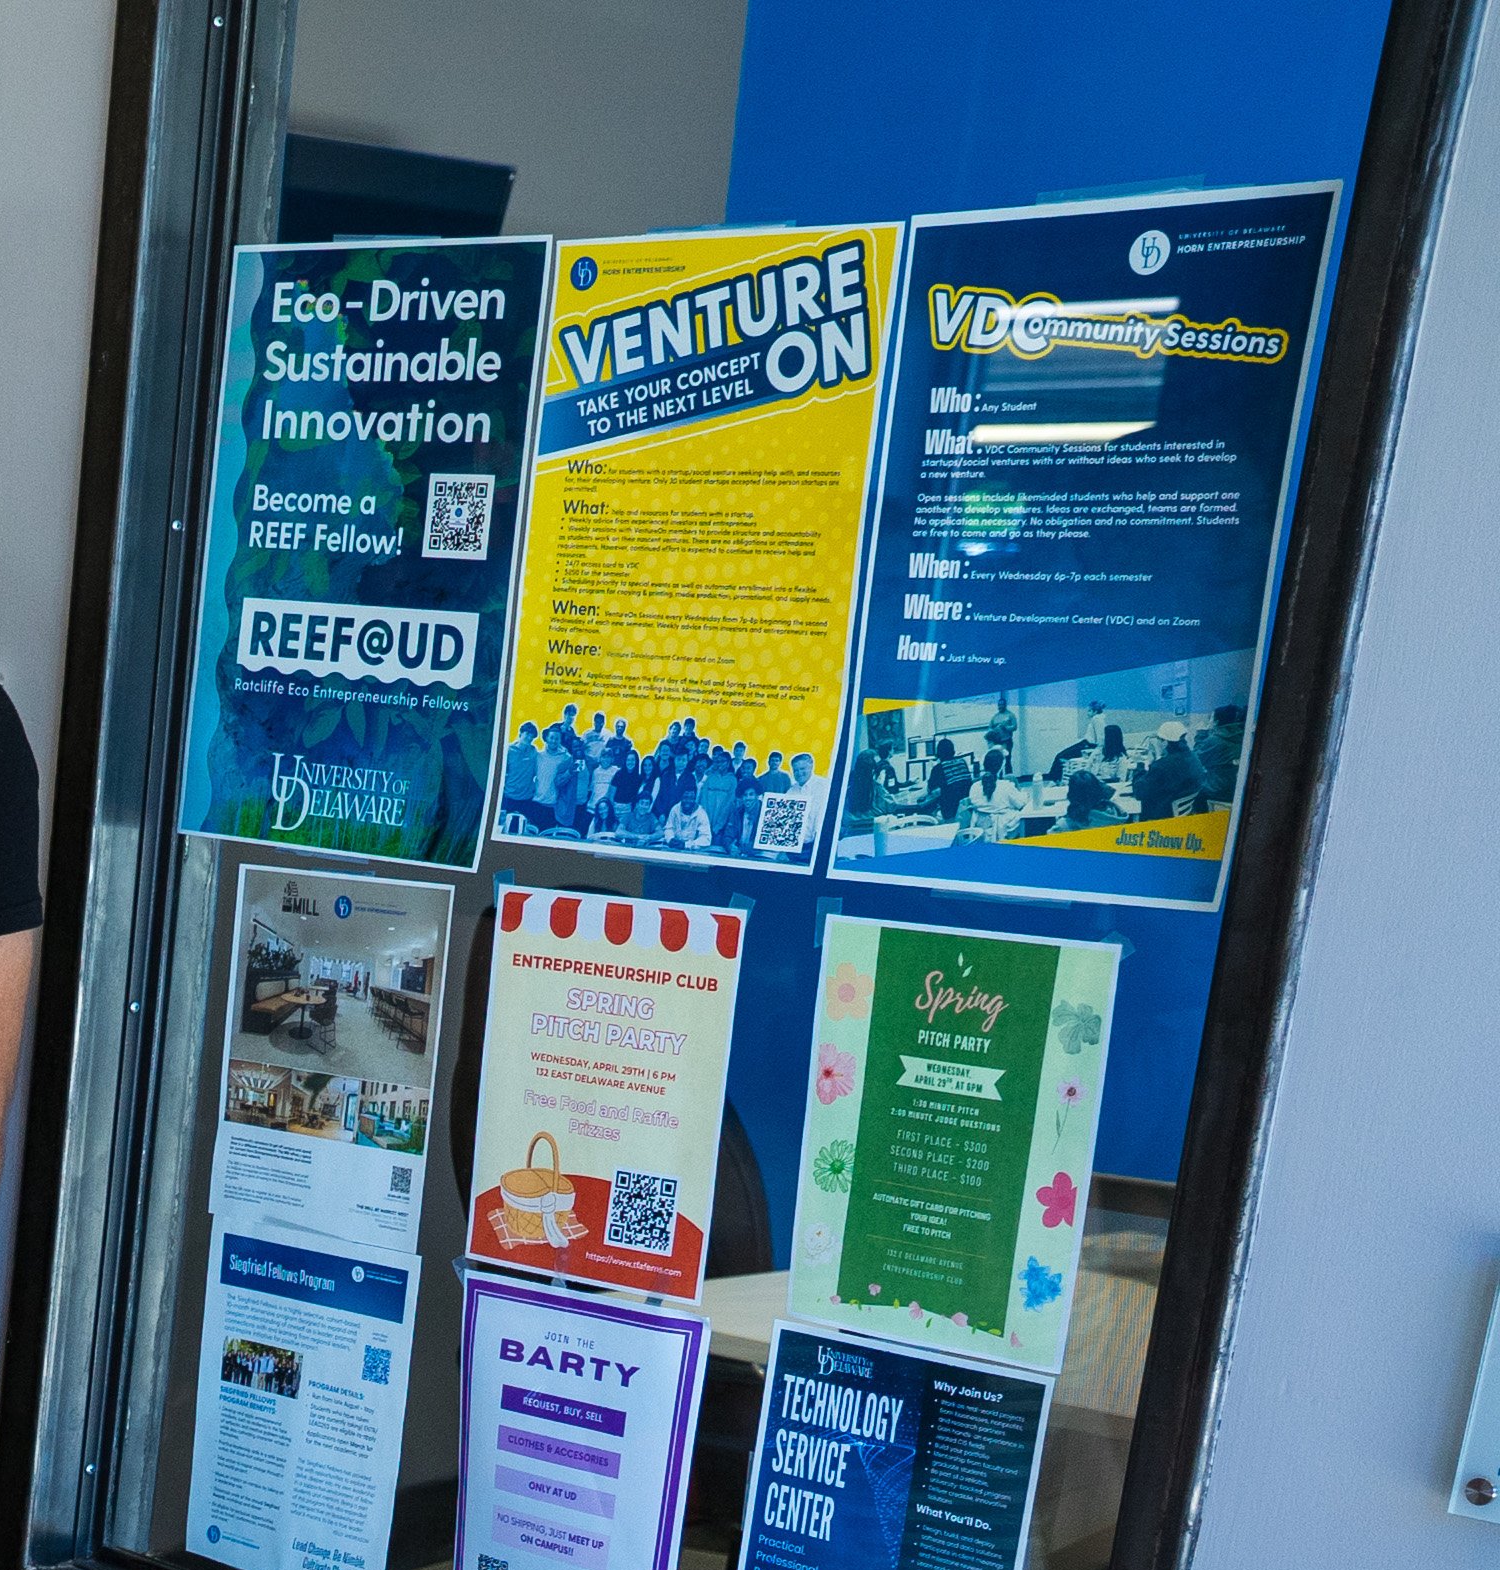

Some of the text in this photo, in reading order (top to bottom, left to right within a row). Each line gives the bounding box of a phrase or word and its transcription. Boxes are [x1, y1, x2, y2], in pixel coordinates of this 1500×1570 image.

[1177, 235, 1306, 254] HORN ENTREPRENEURSHIP
[270, 277, 509, 322] Eco-Driven
[563, 246, 864, 385] VENTURE
[765, 312, 867, 393] ON
[1164, 323, 1281, 356] Sessions
[261, 338, 504, 383] Sustainable
[577, 352, 761, 418] TAKE YOUR CONCEPT
[260, 399, 494, 443] Innovation
[587, 378, 754, 437] TO THE NEXT LEVEL
[980, 403, 999, 412] Any
[1000, 401, 1037, 412] Student
[567, 459, 607, 475] Who:
[251, 485, 377, 515] Become a
[563, 500, 610, 515] What:
[248, 521, 404, 556] REEF Fellow!
[969, 571, 996, 581] Every
[997, 571, 1052, 582] Wednesday
[1053, 571, 1081, 582] 6p-7p
[1083, 572, 1107, 582] each
[1108, 572, 1152, 583] semester
[552, 600, 600, 617] When:
[971, 612, 1007, 622] Venture
[1008, 613, 1069, 624] Development
[1071, 614, 1103, 625] Center
[1104, 615, 1134, 625] (VDC)
[1135, 616, 1155, 626] and
[1157, 616, 1170, 626] on
[1172, 616, 1200, 627] Zoom
[248, 610, 466, 672] REEF@UD
[548, 639, 601, 656] Where:
[544, 661, 582, 678] How:
[945, 653, 965, 664] Just
[967, 654, 991, 664] show
[992, 655, 1007, 665] up.
[233, 678, 469, 714] Ratcliffe Eco Entrepreneurship Fellows
[272, 753, 410, 798] UNIVERSITY OF
[271, 776, 405, 831] DELAWARE
[1116, 829, 1205, 853] Just Show Up.
[293, 897, 320, 917] MILL
[512, 953, 718, 991] ENTREPRENEURSHIP CLUB
[565, 987, 655, 1020] SPRING
[915, 970, 1009, 1033] Spring
[530, 1012, 687, 1057] PITCH PARTY
[918, 1030, 992, 1054] PITCH PARTY
[530, 1051, 676, 1083] WEDNESDAY, APRIL 29TH 6 PM
[535, 1067, 666, 1096] 132 EAST DELAWARE AVENUE
[925, 1062, 972, 1079] WEDNESDAY,
[914, 1072, 934, 1086] APRIL
[955, 1078, 964, 1091] AT
[966, 1080, 983, 1094] 6PM
[523, 1089, 679, 1130] Free Food and Raffle
[567, 1118, 621, 1142] Prizzes
[897, 1129, 988, 1154] FIRST PLACE $300
[890, 1146, 990, 1172] SECOND PLACE $200
[893, 1162, 982, 1188] THIRD PLACE $100
[228, 1253, 335, 1293] Siegfried Fellows Program
[544, 1331, 595, 1350] JOIN THE
[499, 1337, 640, 1390] BARTY
[932, 1379, 1003, 1404] Why Join Us?
[522, 1395, 603, 1424] REQUEST, BUY, SELL
[777, 1373, 904, 1443] TECHNOLOGY
[507, 1434, 609, 1468] CLOTHES & ACCESORIES
[770, 1428, 851, 1488] SERVICE
[528, 1480, 577, 1502] ONLY AT UD
[762, 1481, 836, 1541] CENTER
[915, 1503, 992, 1531] What You'll Do.
[496, 1512, 604, 1551] NO SHIPPING, JUST MEET UP
[520, 1533, 574, 1556] ON CAMPUS!!
[757, 1534, 806, 1555] Practical.
